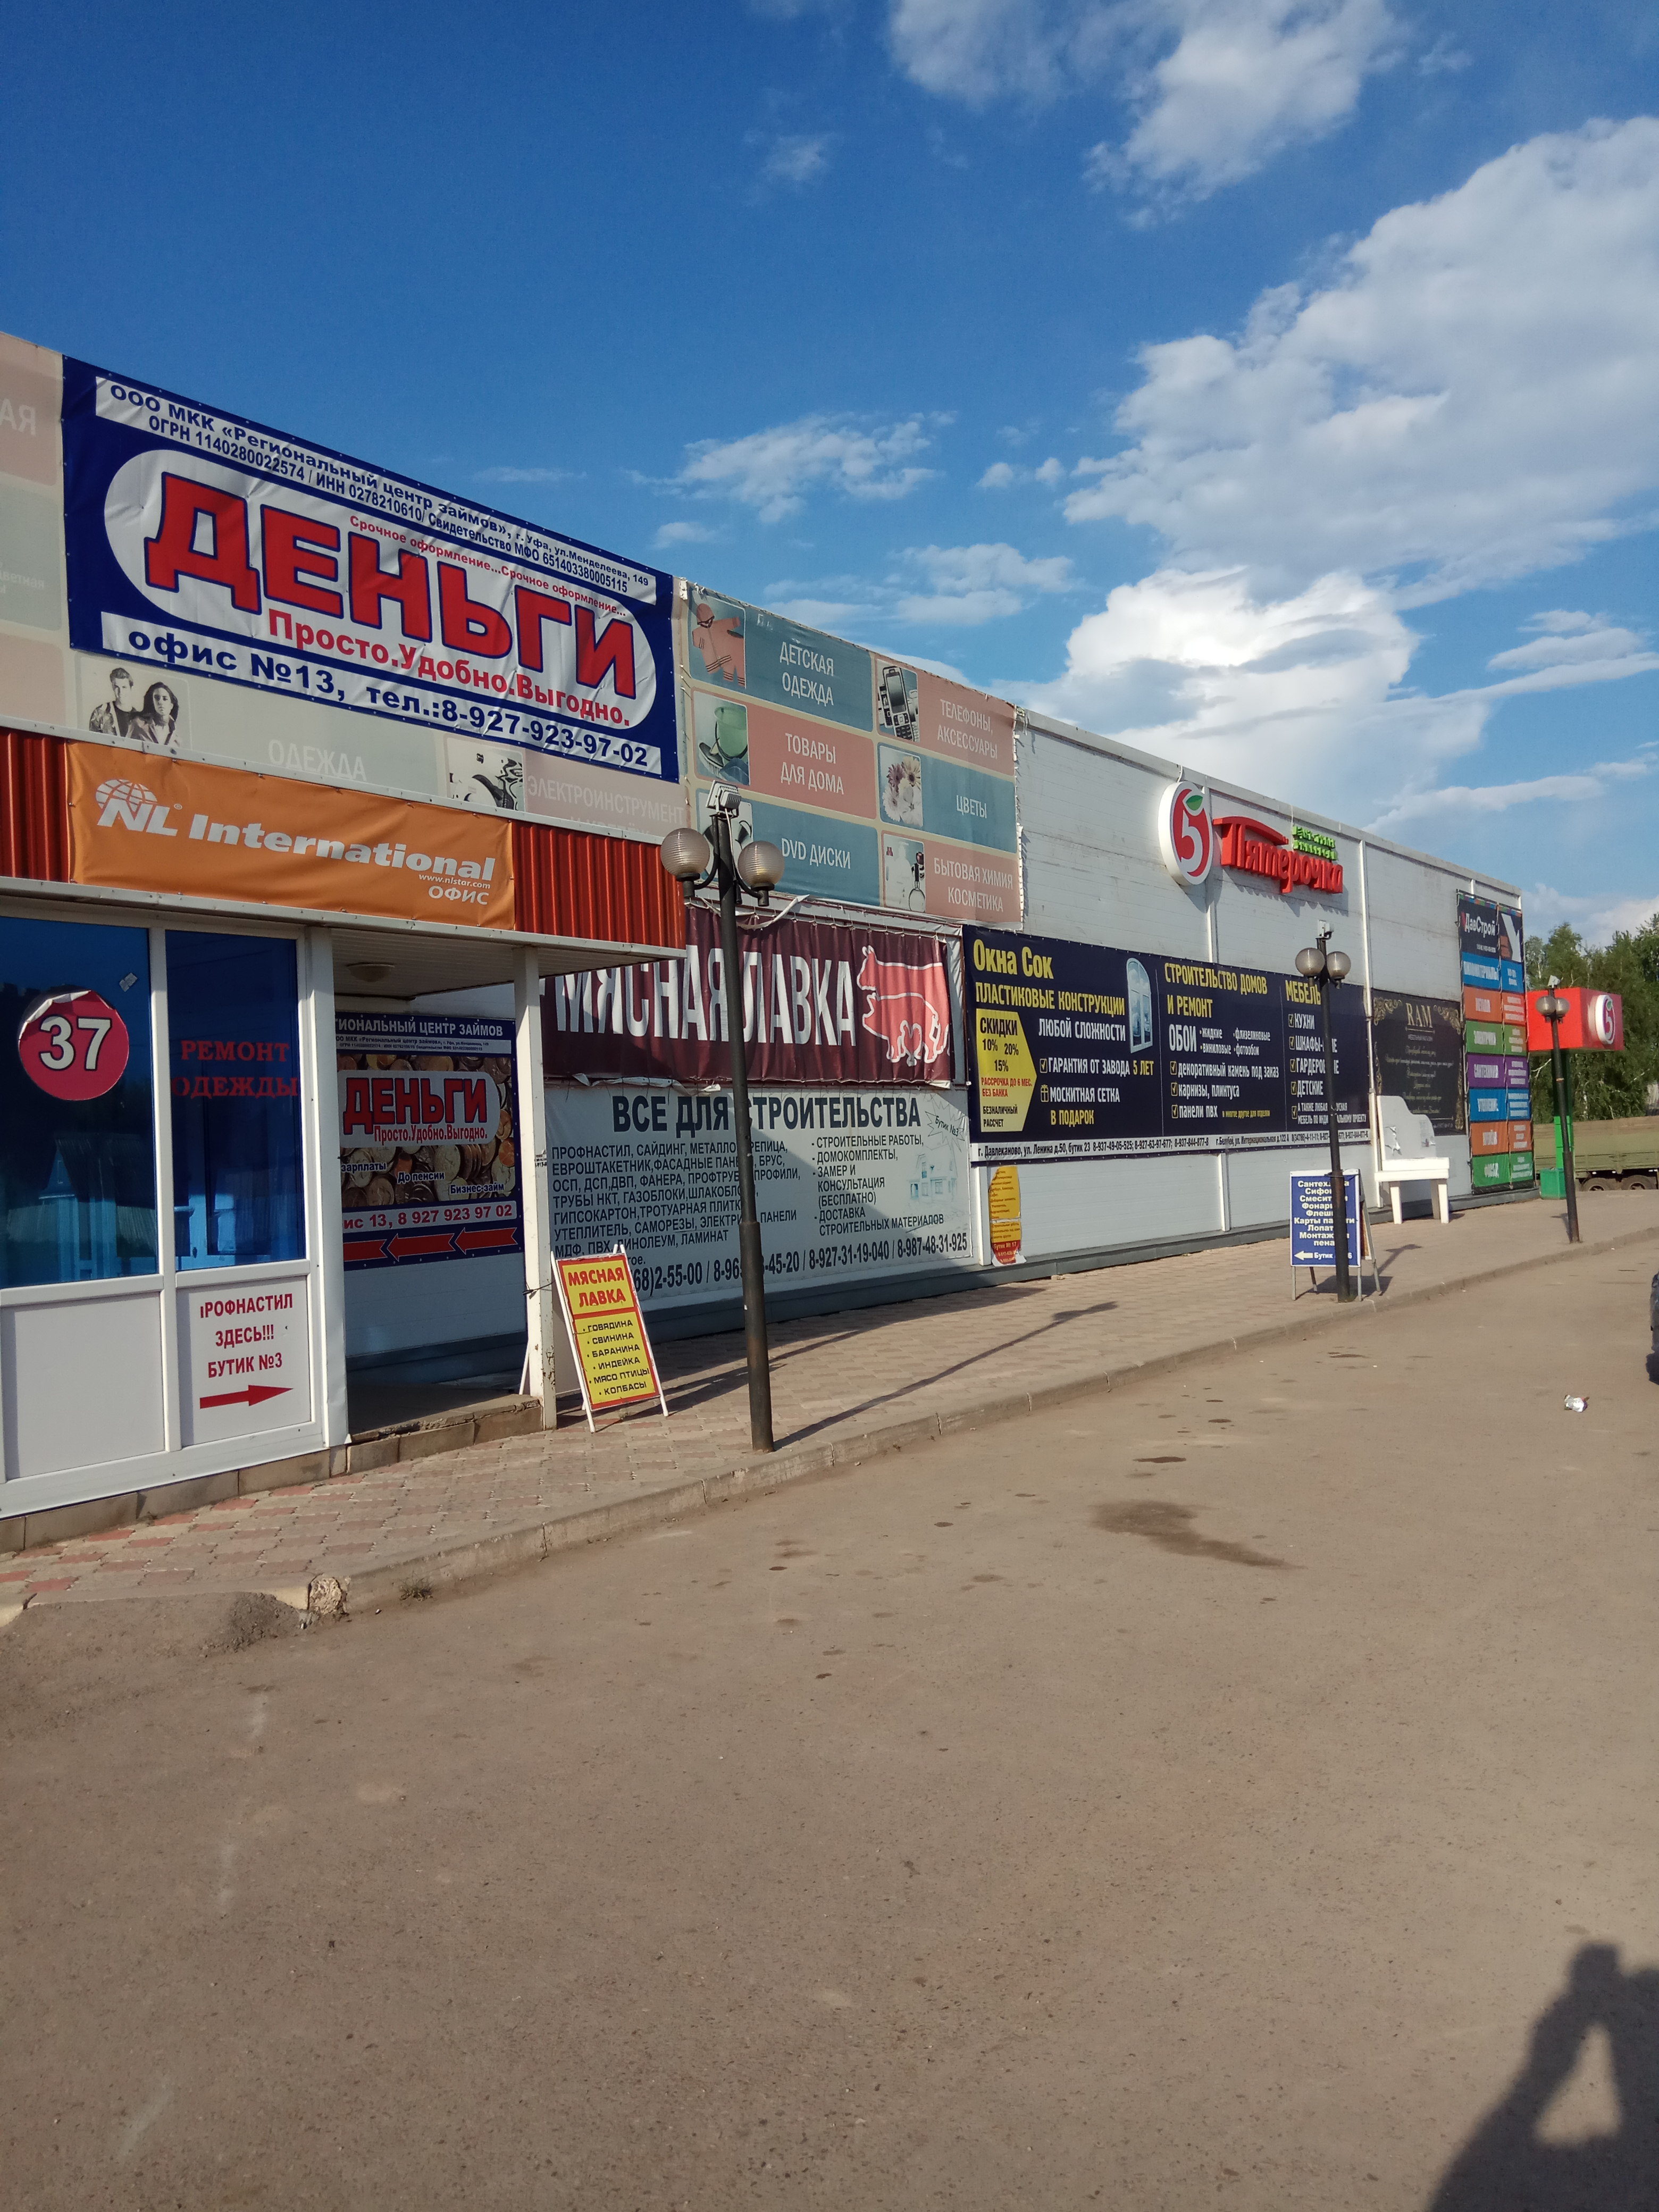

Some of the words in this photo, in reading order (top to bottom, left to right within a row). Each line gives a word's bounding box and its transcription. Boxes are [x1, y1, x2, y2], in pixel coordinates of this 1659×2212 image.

[110, 383, 161, 413] ООО
[168, 403, 215, 433] МКК
[222, 425, 378, 489] «Региональный
[383, 476, 432, 510] центр
[438, 501, 512, 539] займов»,
[526, 533, 552, 553] Уфа,
[632, 574, 649, 586] 149
[148, 415, 190, 442] ОГРН
[195, 430, 305, 481] 1140280022574
[315, 473, 346, 498] ИНН
[428, 513, 512, 551] Свидетельство
[514, 543, 540, 562] МФО
[542, 553, 628, 593] 651403380005115
[350, 515, 407, 543] Срочное
[144, 471, 636, 700] ДЕНЬГИ
[128, 631, 238, 672] офис
[250, 653, 346, 702] №13,
[779, 641, 834, 677] ДЕТСКАЯ
[782, 676, 834, 707] ОДЕЖДА
[940, 698, 993, 736] ТЕЛЕФОНЫ,
[785, 732, 836, 765] ТОВАРЫ
[937, 724, 998, 759] АКСЕССУАРЫ
[269, 739, 367, 782] ОДЕЖДА
[780, 761, 805, 786] ДЛЯ
[808, 768, 844, 795] ДОМА
[526, 775, 684, 825] ЭЛЕКТРОИНСТРУМЕНТ
[956, 794, 987, 819] ЦВЕТЫ
[188, 814, 497, 882] International
[782, 838, 807, 861] DVD
[809, 845, 851, 869] ДИСКИ
[418, 873, 491, 890] www.nlstar.com
[934, 857, 980, 883] БЫТОВАЯ
[982, 868, 1013, 890] ХИМИЯ
[428, 885, 490, 906] ОФИС
[948, 887, 1004, 913] КОСМЕТИКА
[973, 939, 1017, 975] Окна
[1021, 946, 1054, 979] Сок
[1164, 962, 1238, 992] СТРОИТЕЛЬСТВО
[1240, 974, 1268, 995] ДОМОВ
[555, 944, 729, 1042] МЯСНАЯ
[743, 951, 857, 1046] ЛАВКА
[975, 982, 1055, 1010] ПЛАСТИКОВЫЕ
[1058, 991, 1125, 1016] КОНСТРУКЦИИ
[1285, 979, 1322, 1006] МЕБЕЛЬ
[1167, 994, 1174, 1015] И
[1176, 996, 1213, 1018] РЕМОНТ
[336, 1016, 416, 1033] ИОНАЛЬНЫЙ
[420, 1022, 456, 1035] ЦЕНТР
[459, 1022, 503, 1036] ЗАЙМОВ
[979, 1017, 1018, 1037] СКИДКИ
[1038, 1017, 1072, 1039] ЛЮБОЙ
[1075, 1020, 1126, 1042] СЛОЖНОСТИ
[1294, 1012, 1315, 1030] КУХНИ
[39, 1015, 113, 1071] 37
[982, 1038, 998, 1052] 10%
[1003, 1043, 1019, 1056] 20%
[1169, 1023, 1197, 1053] ОБОИ
[1201, 1027, 1223, 1040] жидкие
[180, 1040, 290, 1063] РЕМОНТ
[1202, 1044, 1232, 1055] виниловые
[994, 1059, 1009, 1073] 15%
[1048, 1056, 1088, 1075] ГАРАНТИЯ
[1090, 1058, 1100, 1074] ОТ
[1102, 1059, 1131, 1077] ЗАВОДА
[1139, 1061, 1154, 1077] ЛЕТ
[1177, 1062, 1226, 1079] декоративный
[1227, 1064, 1250, 1078] камень
[1251, 1065, 1262, 1080] под
[1263, 1065, 1280, 1079] заказ
[170, 1076, 298, 1099] ОДЕЖДЫ
[981, 1077, 1009, 1086] РАССРОЧКА
[1296, 1080, 1324, 1097] ДЕТСКИЕ
[992, 1088, 1008, 1097] БАНКА
[1050, 1087, 1095, 1103] МОСКИТНАЯ
[1097, 1087, 1120, 1103] СЕТКА
[1178, 1084, 1210, 1100] карнизы,
[1211, 1084, 1240, 1101] плинтуса
[343, 1078, 488, 1135] ДЕНЬГИ
[983, 1104, 1018, 1115] БЕЗНАЛИЧНЫЙ
[1179, 1105, 1204, 1119] панели
[1205, 1105, 1218, 1118] пвх
[611, 1095, 668, 1133] ВСЕ
[675, 1096, 730, 1139] ДЛЯ
[748, 1096, 921, 1130] ТРОИТЕЛЬСТВА
[934, 1115, 950, 1132] Бутик
[983, 1118, 1004, 1127] РАССЧЕТ
[1058, 1109, 1095, 1128] ПОДАРОК
[551, 1144, 634, 1160] ПРОФНАСТИЛ,
[636, 1141, 688, 1157] САЙДИНГ,
[817, 1136, 887, 1149] СТРОИТЕЛЬНЫЕ
[889, 1134, 924, 1147] РАБОТЫ,
[984, 1145, 1023, 1159] Давлеканово,
[1033, 1144, 1053, 1155] Ленина
[341, 1161, 387, 1173] зарплаты
[759, 1154, 785, 1168] БРУС,
[817, 1149, 898, 1166] ДОМОКОМПЛЕКТЫ,
[398, 1172, 411, 1183] До
[413, 1172, 445, 1182] пенсии
[552, 1178, 581, 1193] ОСП,
[640, 1172, 685, 1187] ФАНЕРА,
[755, 1167, 800, 1182] ПРОФИЛИ,
[817, 1164, 847, 1178] ЗАМЕР
[450, 1183, 505, 1194] Бизнес-займ
[818, 1177, 885, 1193] КОНСУЛЬТАЦИЯ
[553, 1193, 593, 1209] ТРУБЫ
[597, 1193, 620, 1206] НКТ,
[818, 1191, 877, 1211] (БЕСПЛАТНО)
[412, 1210, 440, 1223] 927
[444, 1208, 471, 1222] 923
[475, 1205, 492, 1218] 97
[496, 1204, 513, 1217] 02
[819, 1206, 866, 1224] ДОСТАВКА
[555, 1225, 632, 1242] УТЕПЛИТЕЛЬ,
[634, 1217, 698, 1234] САМОРЕЗЫ,
[760, 1210, 797, 1224] ПАНЕЛИ
[819, 1219, 890, 1237] СТРОИТЕЛЬНЫХ
[891, 1214, 944, 1229] МАТЕРИАЛОВ
[555, 1244, 585, 1259] МДФ,
[681, 1229, 729, 1246] ЛАМИНАТ
[809, 1239, 890, 1270] 8-927-31-19-040
[897, 1232, 968, 1258] 8-987-48-31-925
[568, 1267, 625, 1286] МЯСНАЯ
[579, 1288, 626, 1308] ЛАВКА
[587, 1319, 633, 1332] ГОВЯДИНА
[215, 1324, 274, 1349] ЗДЕСЬ!!!
[592, 1332, 634, 1345] СВИНИНА
[591, 1344, 640, 1358] БАРАНИНА
[208, 1356, 255, 1378] БУТИК
[258, 1352, 283, 1371] №3
[598, 1356, 640, 1370] ИНДЕЙКА
[593, 1373, 618, 1384] МЯСО
[619, 1367, 650, 1380] ПТИЦЫ
[604, 1381, 647, 1395] КОЛБАСЫ
